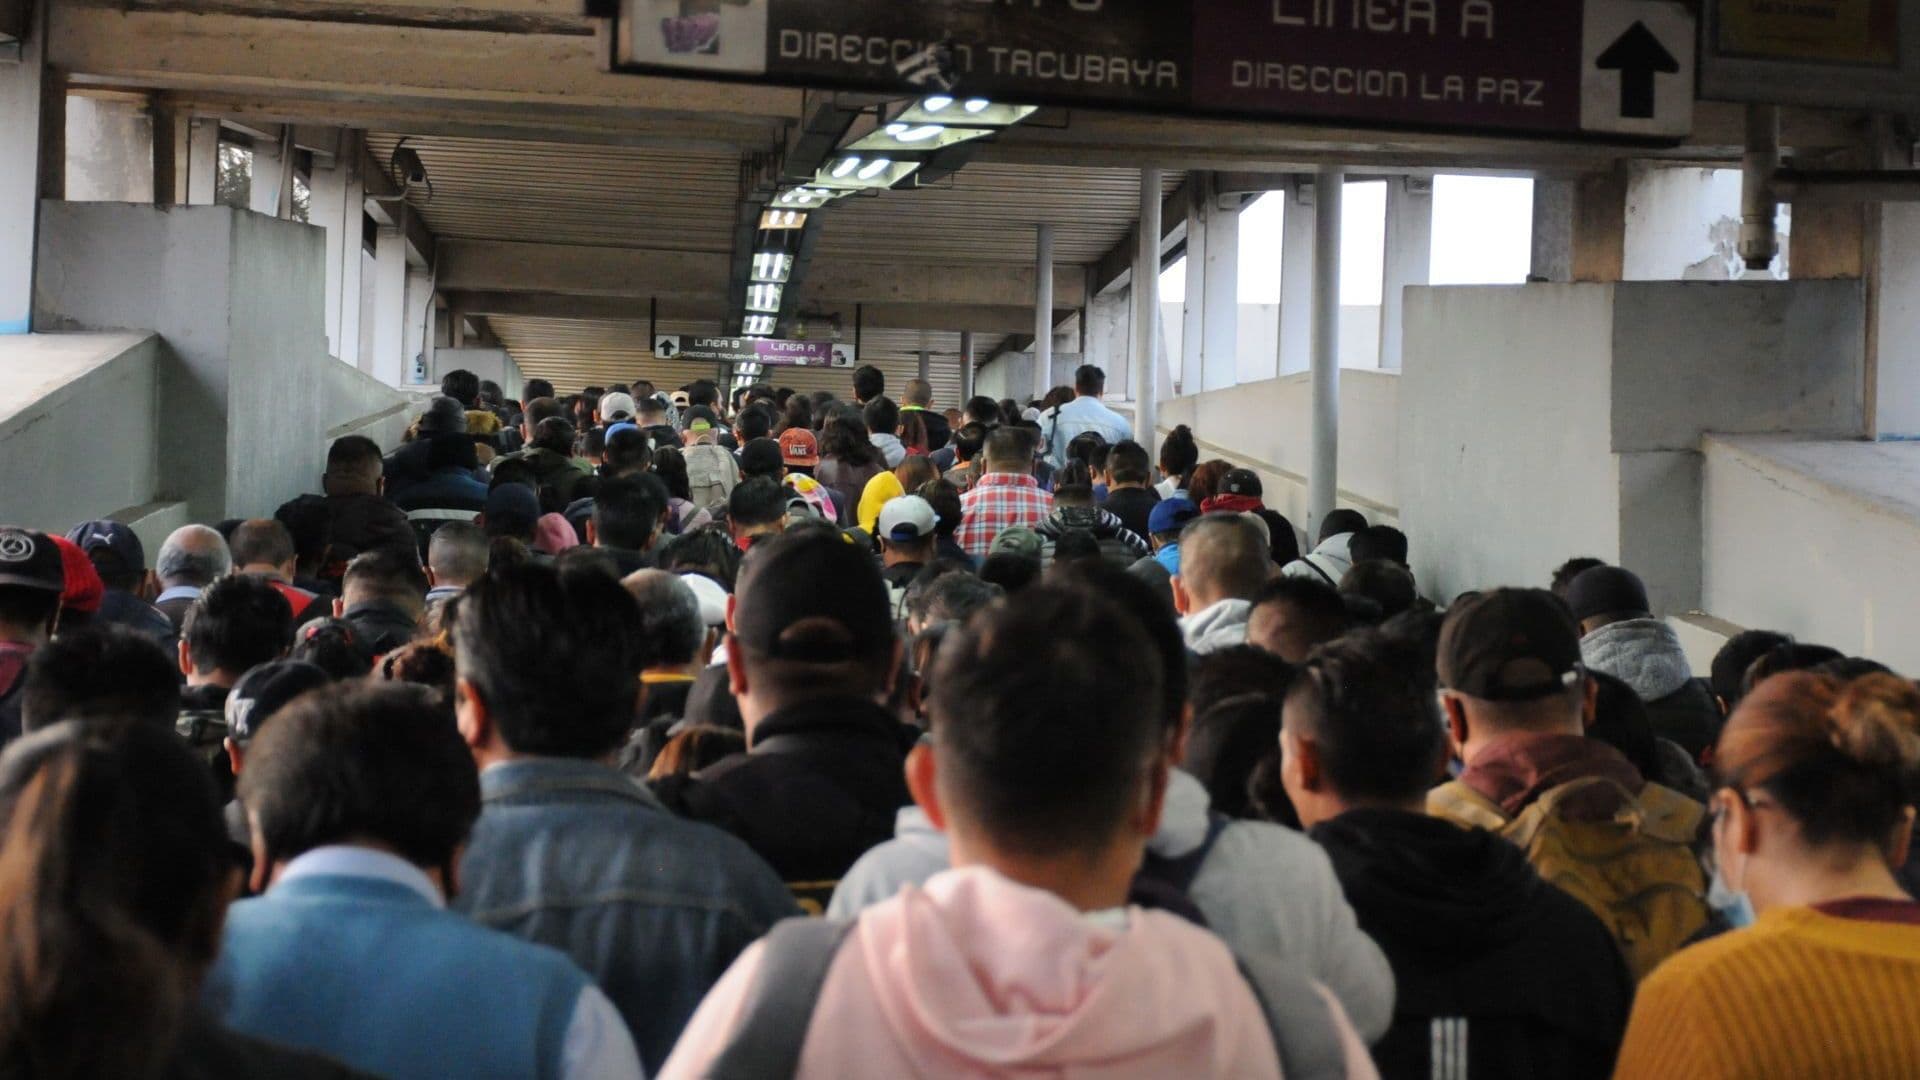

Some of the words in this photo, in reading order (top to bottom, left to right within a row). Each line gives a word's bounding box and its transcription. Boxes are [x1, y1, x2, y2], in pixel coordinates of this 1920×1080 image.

[1273, 0, 1438, 35] LINEA
[1460, 0, 1494, 39] A
[986, 47, 1179, 88] TACUBAYA
[1231, 59, 1408, 98] DIRECCION
[1420, 73, 1464, 102] LA
[1476, 76, 1545, 107] PAZ
[694, 338, 729, 348] LINEA
[770, 343, 805, 352] LINEA
[807, 344, 816, 353] A
[789, 443, 807, 456] VANS
